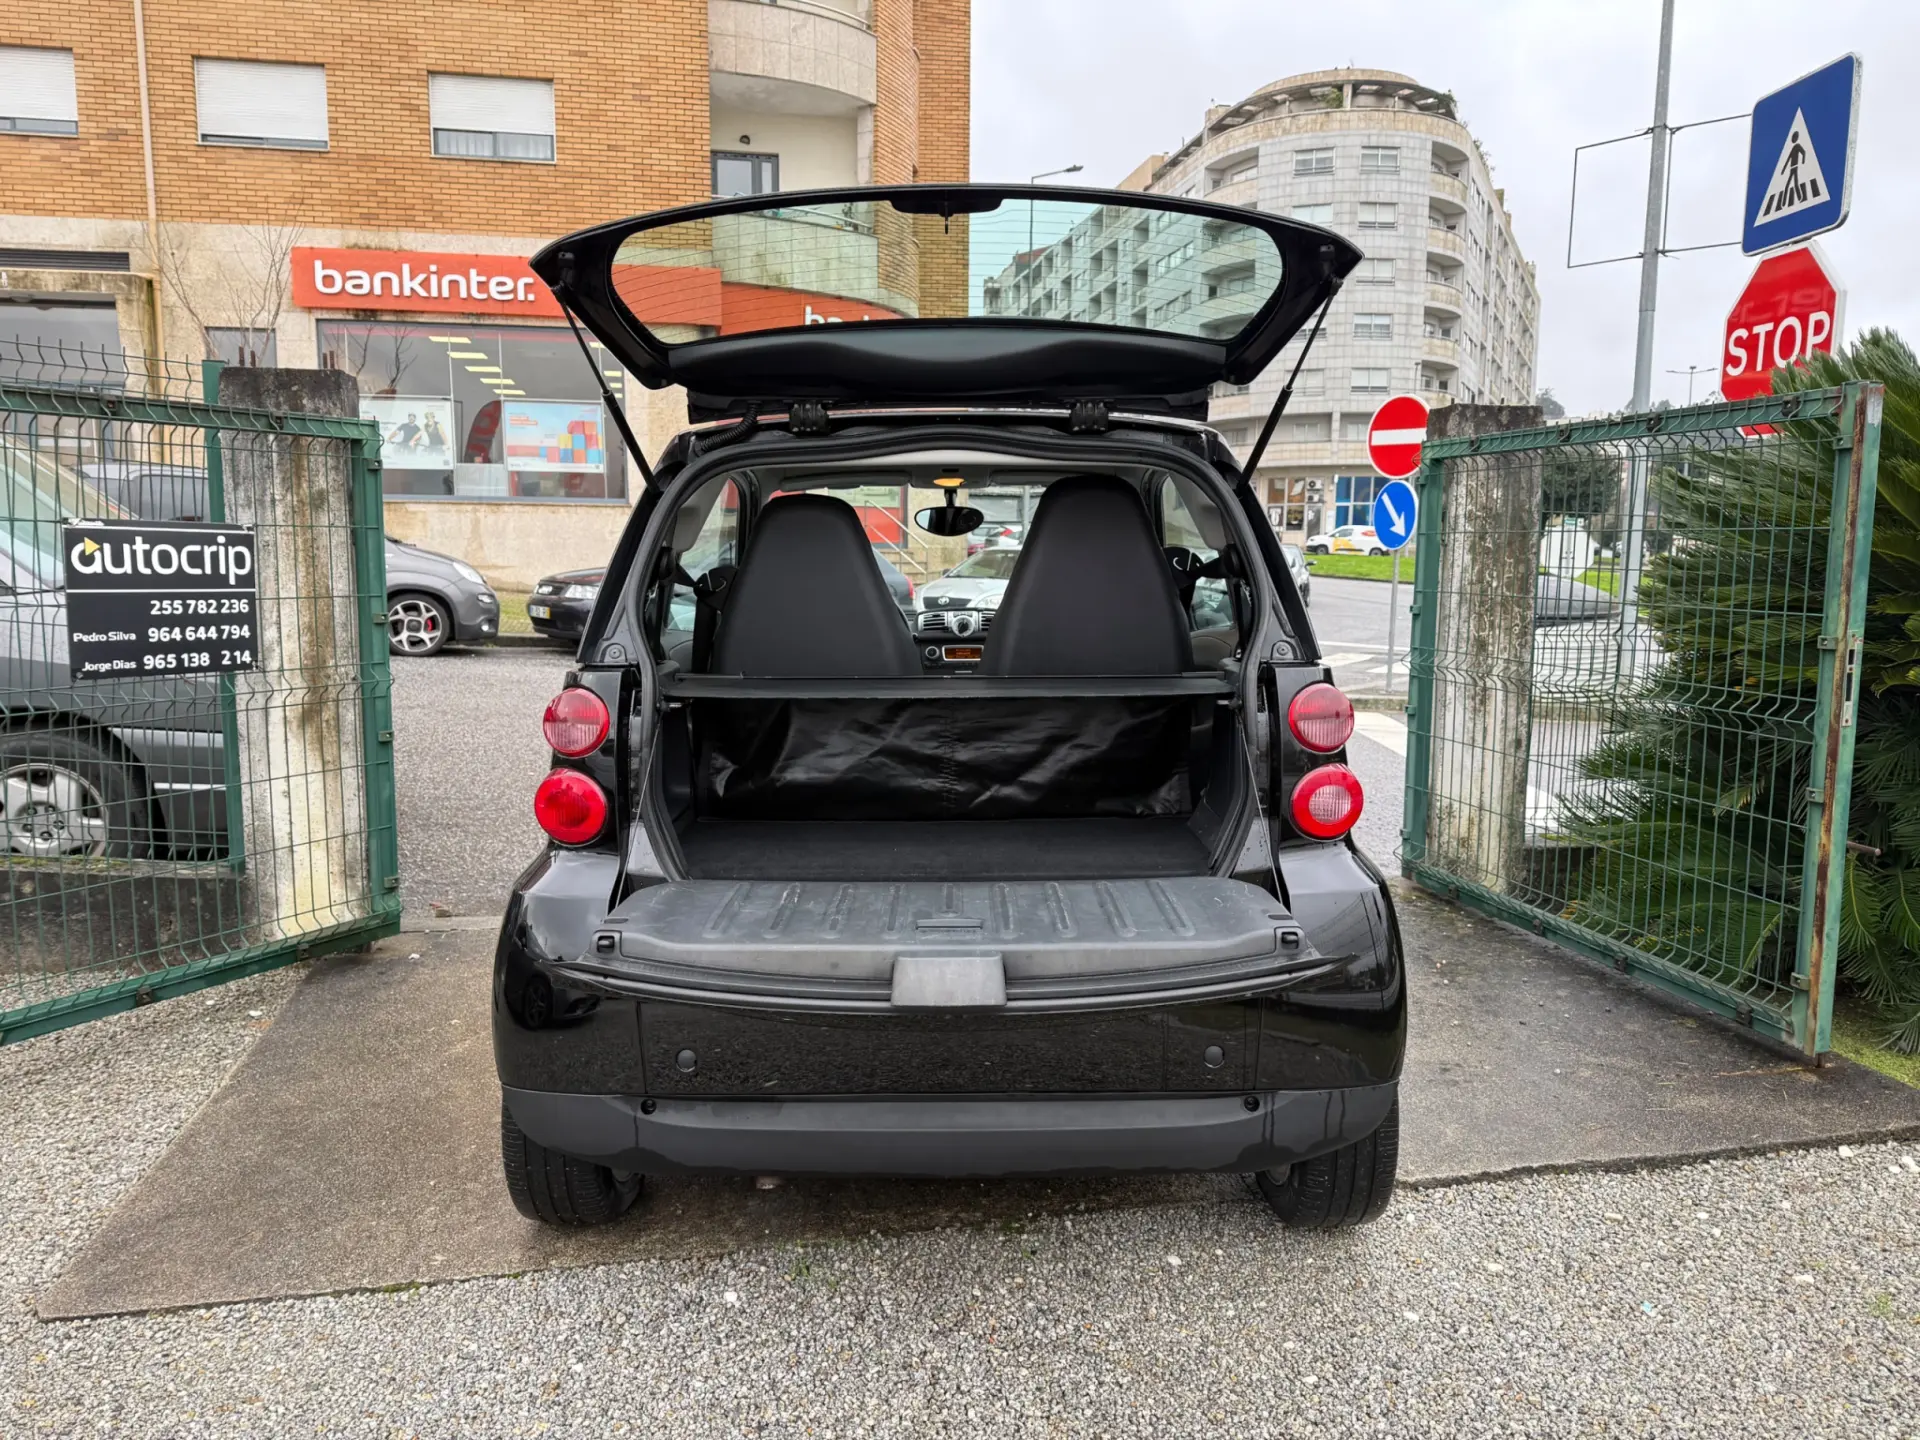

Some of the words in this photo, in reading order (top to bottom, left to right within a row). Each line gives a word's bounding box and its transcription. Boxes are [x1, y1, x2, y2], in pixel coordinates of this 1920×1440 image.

[313, 259, 536, 302] bankinter.
[1725, 310, 1831, 377] STOP
[70, 535, 252, 586] autocrip
[150, 599, 184, 615] 255
[186, 599, 218, 614] 782
[220, 598, 249, 613] 236
[73, 632, 108, 642] Pedro
[108, 631, 137, 641] Silva
[147, 626, 183, 642] 964
[185, 625, 218, 641] 644
[220, 624, 251, 639] 794
[82, 661, 112, 672] Jorge
[113, 660, 137, 669] Dias
[143, 654, 177, 670] 965
[180, 652, 210, 667] 138
